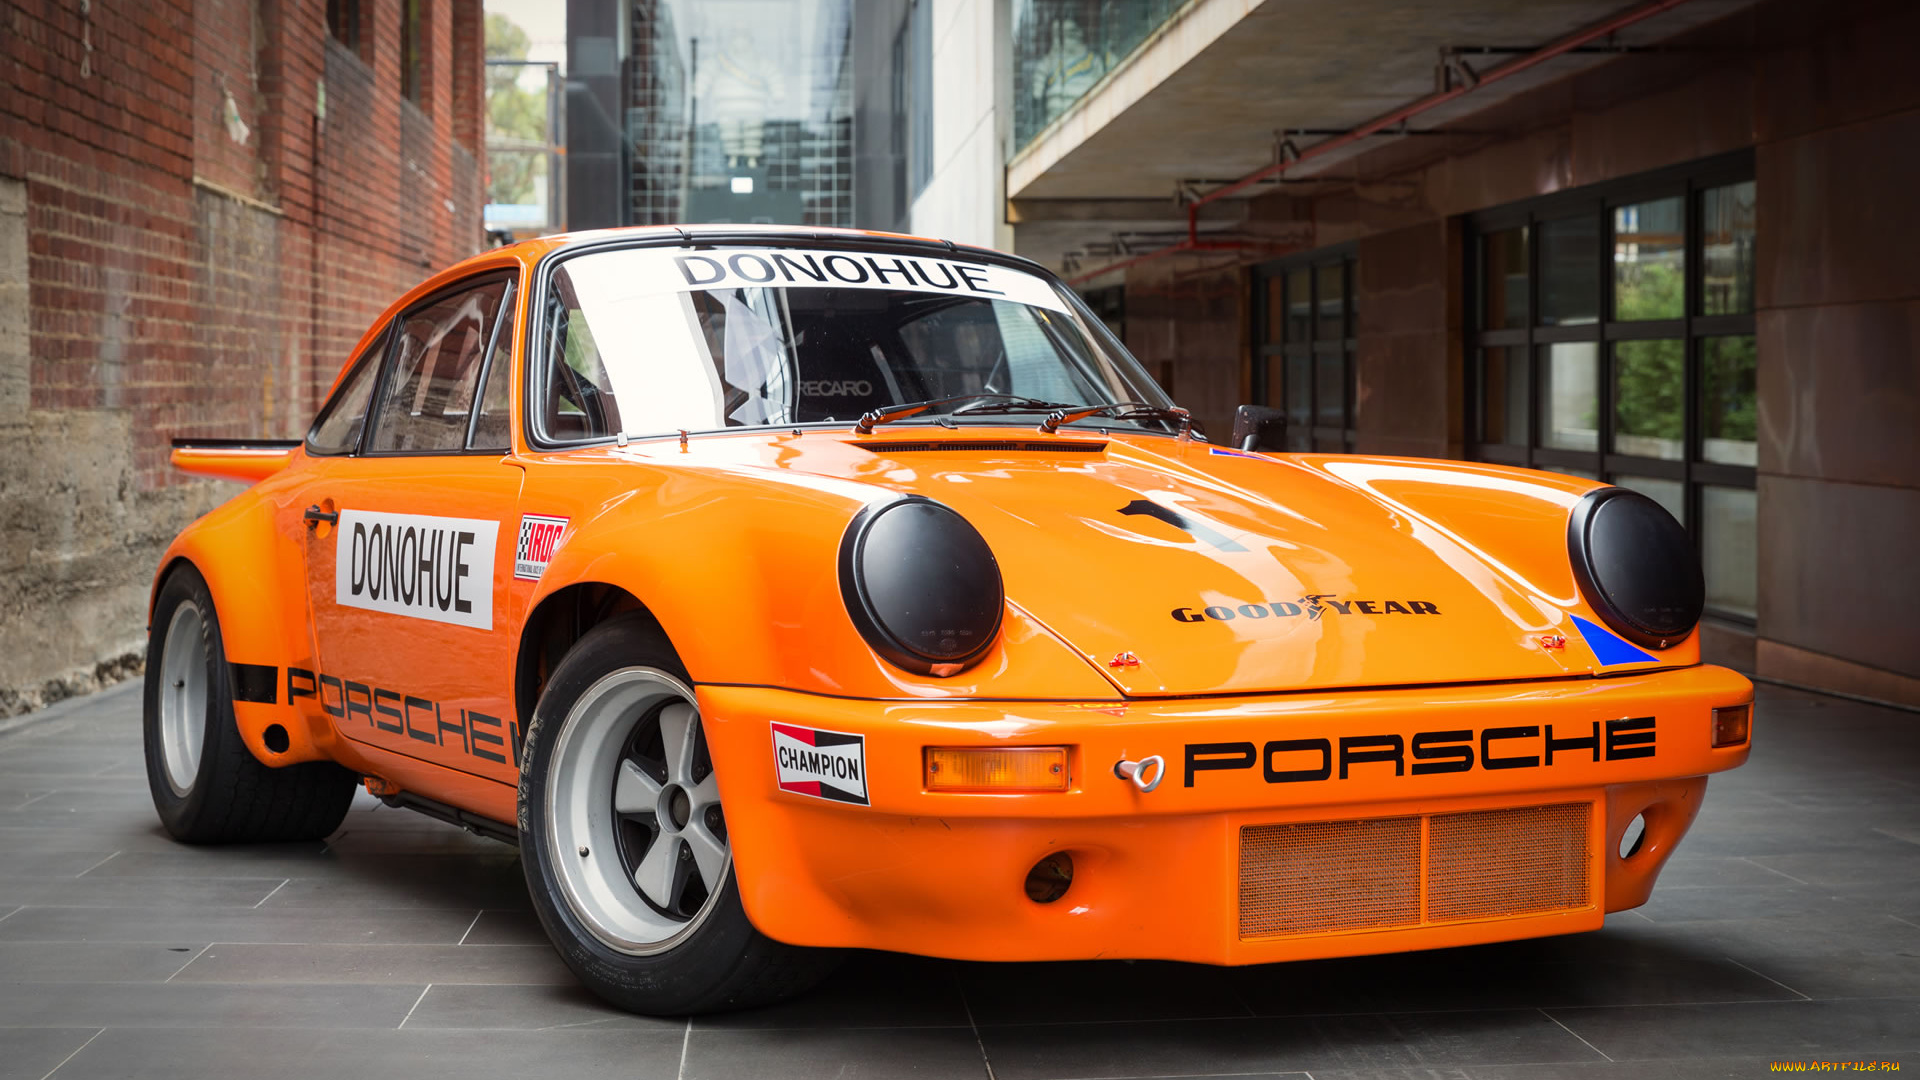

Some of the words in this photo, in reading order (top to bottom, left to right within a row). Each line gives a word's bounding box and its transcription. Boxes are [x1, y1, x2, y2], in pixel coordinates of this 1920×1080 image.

[674, 253, 1006, 295] DONOHUE
[795, 380, 873, 396] RECARO
[527, 523, 563, 563] IROC
[351, 522, 475, 613] DONOHUE
[287, 667, 506, 764] PORSCHE
[778, 745, 859, 781] CHAMPION
[1184, 716, 1656, 787] PORSCHE
